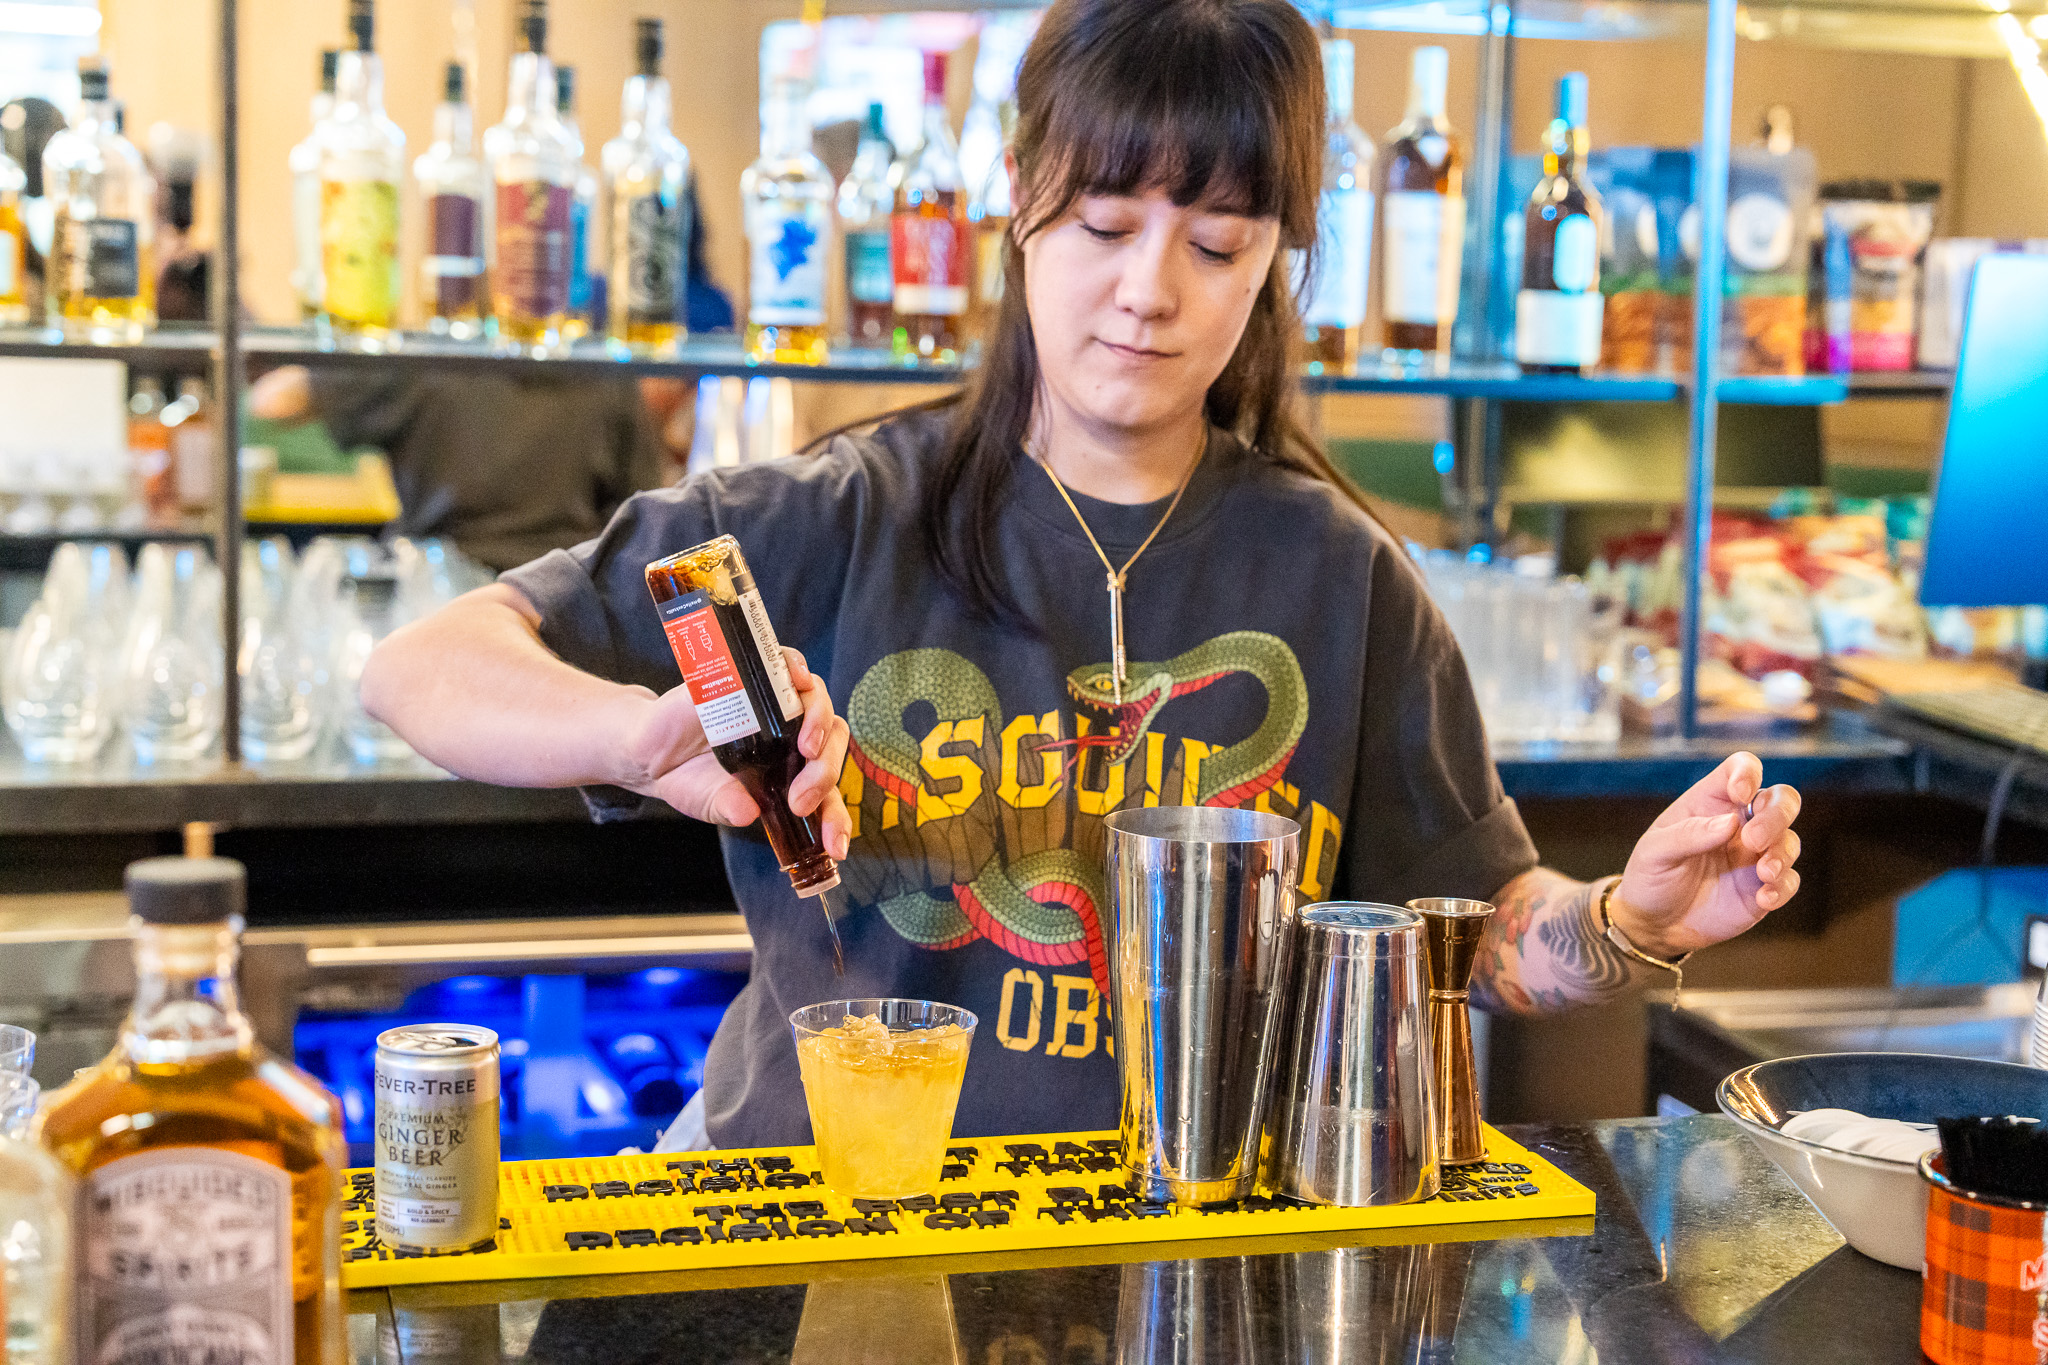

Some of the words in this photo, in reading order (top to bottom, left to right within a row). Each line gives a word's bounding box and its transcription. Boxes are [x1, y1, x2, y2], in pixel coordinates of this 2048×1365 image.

[700, 674, 733, 690] Manhattan
[714, 718, 750, 734] AROMATIC
[836, 709, 1342, 901] SGUID
[996, 968, 1114, 1059] OB
[388, 1111, 445, 1125] PREMIUM
[378, 1123, 464, 1146] GINGER
[389, 1146, 444, 1166] BEER
[667, 1156, 794, 1179] THE
[994, 1156, 1122, 1179] THE
[693, 1200, 828, 1226] THE
[852, 1189, 1020, 1217] BEST
[564, 1216, 898, 1252] DECISION
[923, 1209, 1010, 1231] OF
[1037, 1201, 1171, 1226] THE
